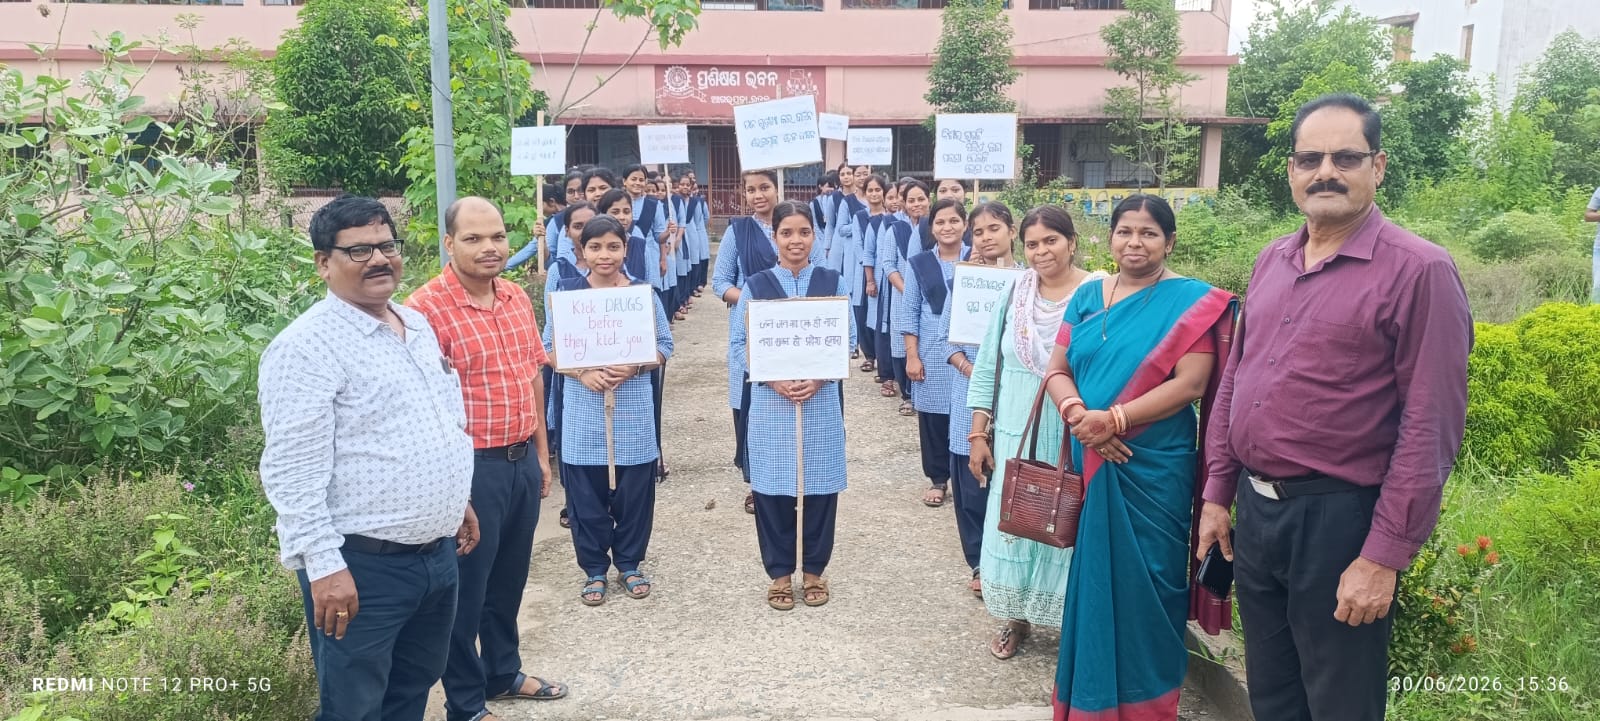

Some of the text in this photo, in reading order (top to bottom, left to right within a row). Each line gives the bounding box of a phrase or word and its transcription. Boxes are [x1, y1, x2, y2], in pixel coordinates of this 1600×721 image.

[745, 70, 778, 89] ଭବନ
[572, 295, 644, 315] Kick DRUGS
[588, 313, 624, 329] before
[562, 329, 643, 361] they kick you
